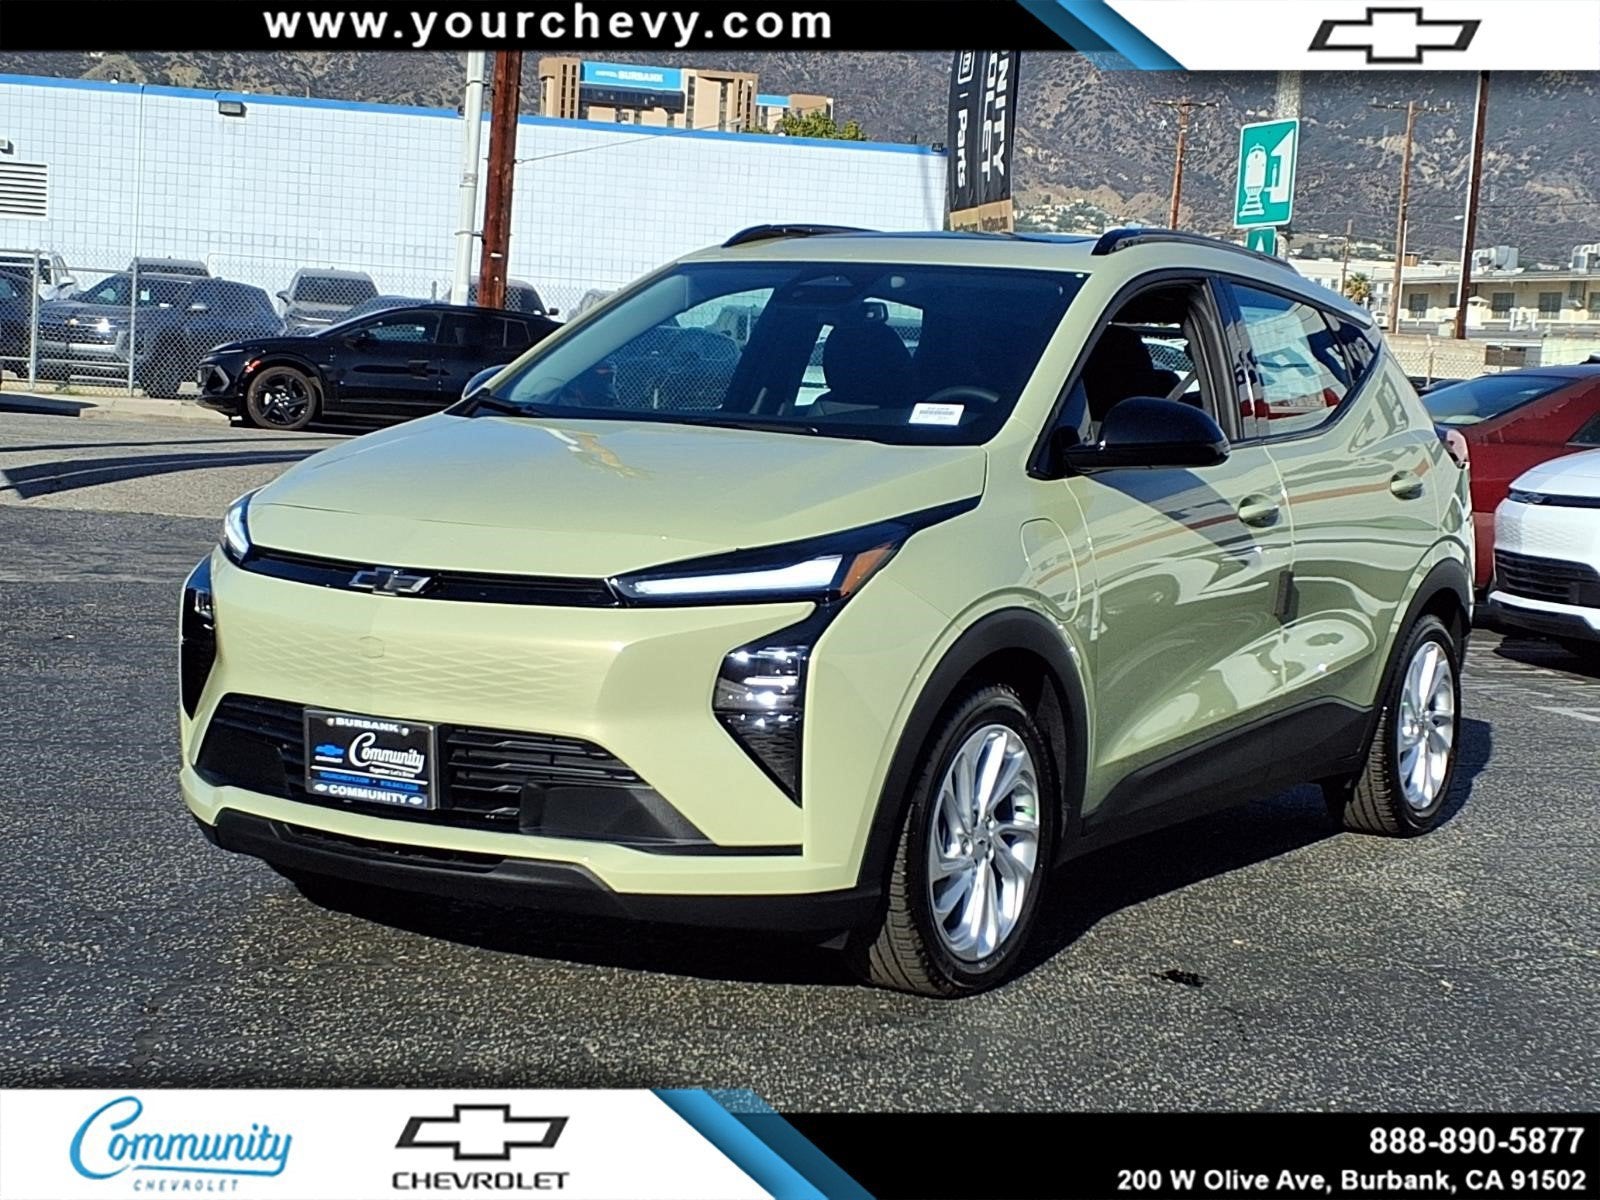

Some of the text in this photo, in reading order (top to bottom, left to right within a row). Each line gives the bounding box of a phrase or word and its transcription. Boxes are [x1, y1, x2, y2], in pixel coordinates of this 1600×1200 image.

[981, 51, 998, 182] OLET
[993, 51, 1010, 176] NITY
[957, 108, 968, 188] Parts
[335, 717, 399, 733] BURBANK
[349, 732, 425, 774] Community
[328, 784, 408, 804] COMMUNITY
